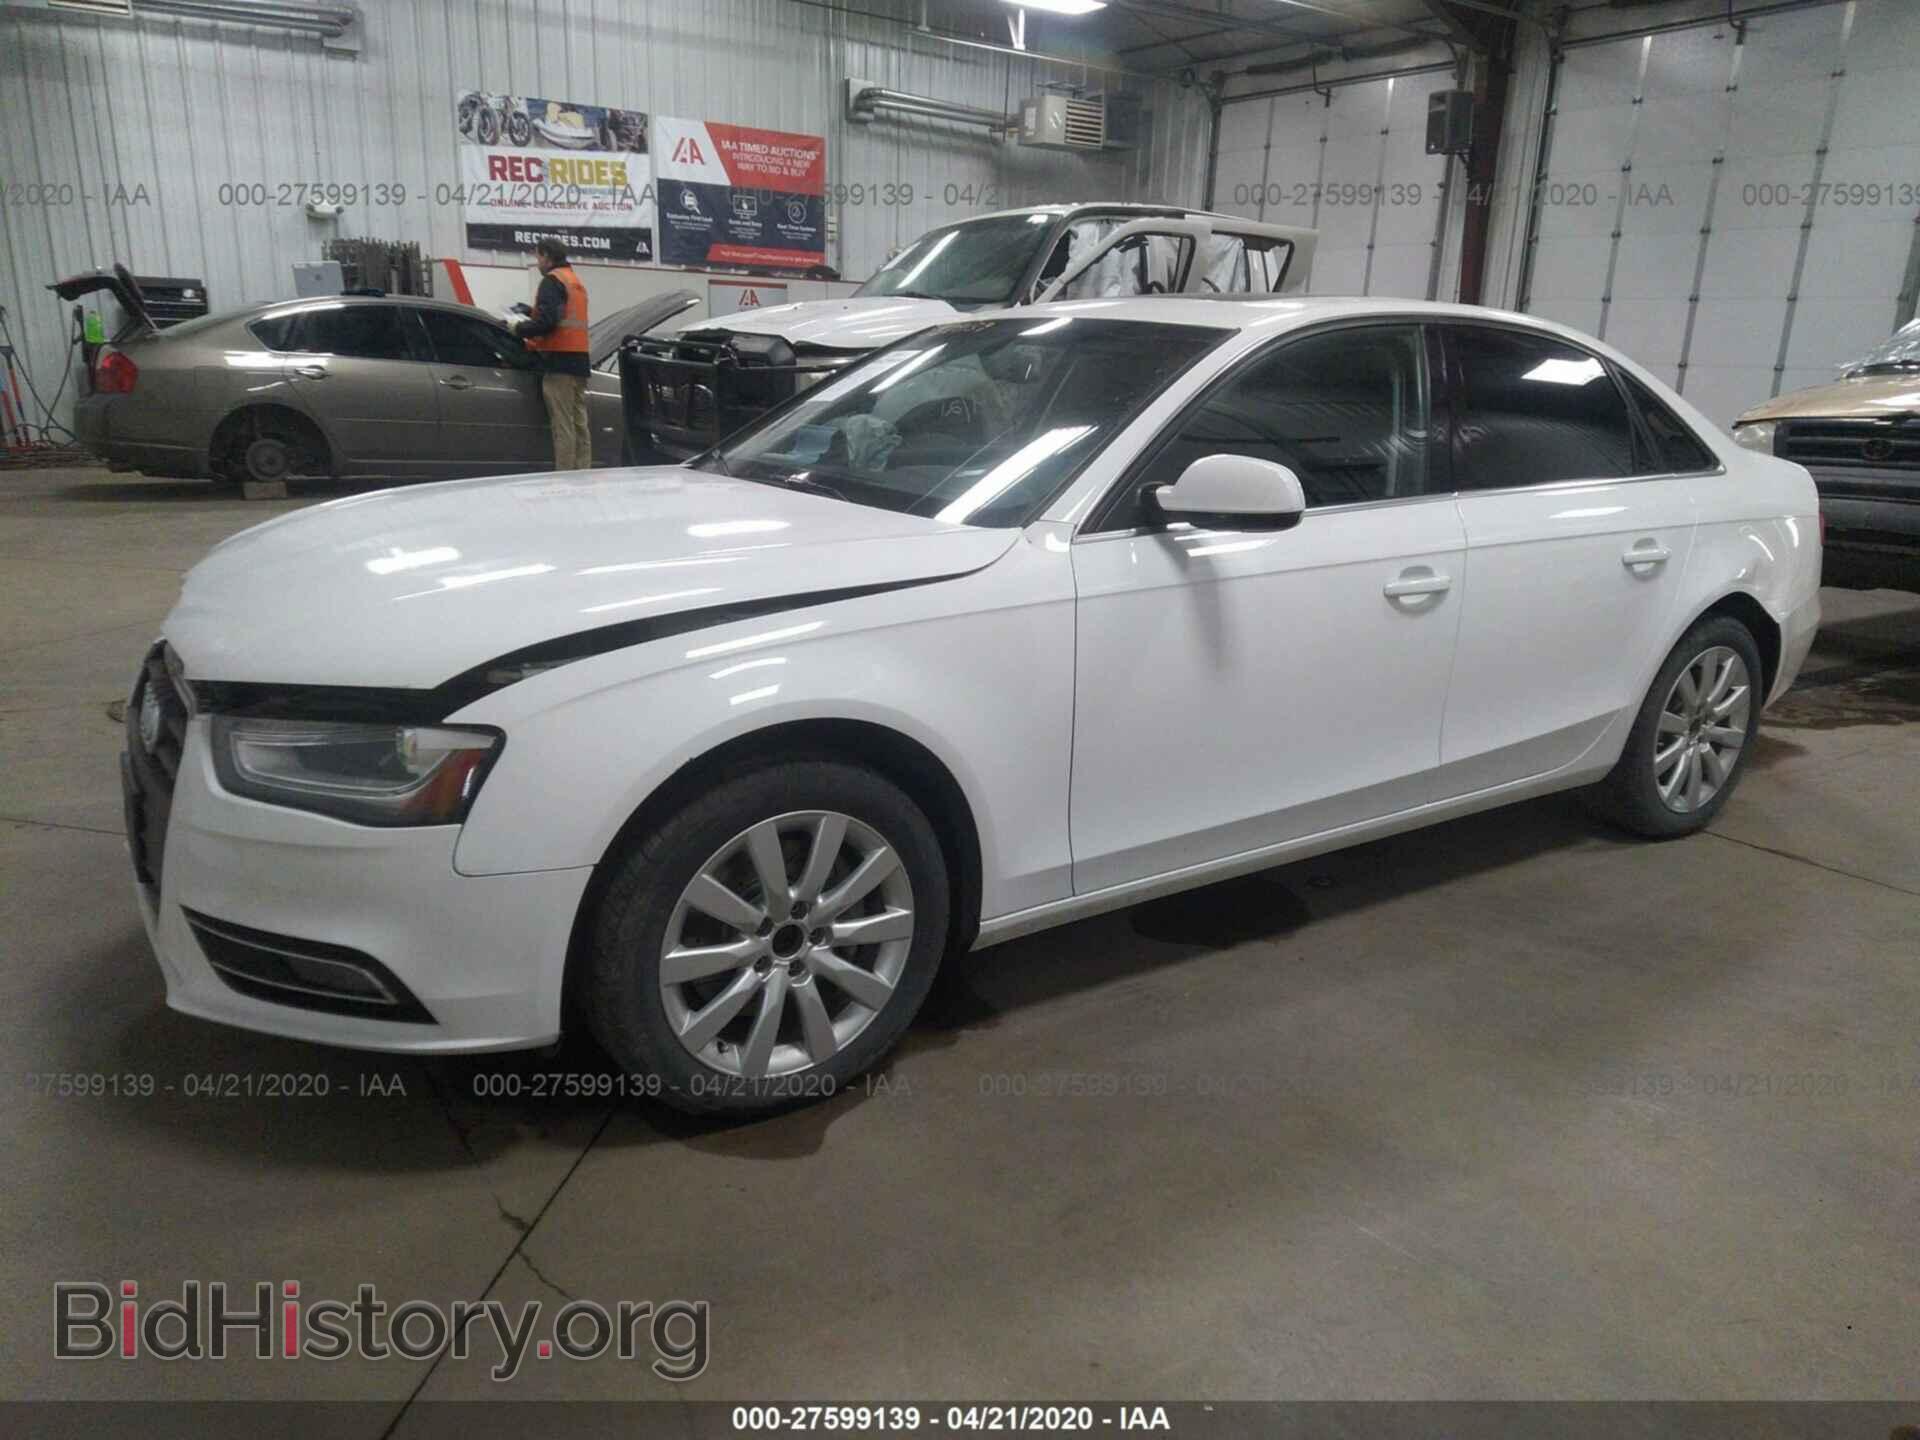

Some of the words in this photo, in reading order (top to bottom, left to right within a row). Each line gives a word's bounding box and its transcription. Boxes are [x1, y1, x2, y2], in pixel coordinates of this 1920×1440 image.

[488, 155, 544, 183] REC
[549, 158, 627, 186] RIDES
[515, 231, 610, 249] RECES.COM
